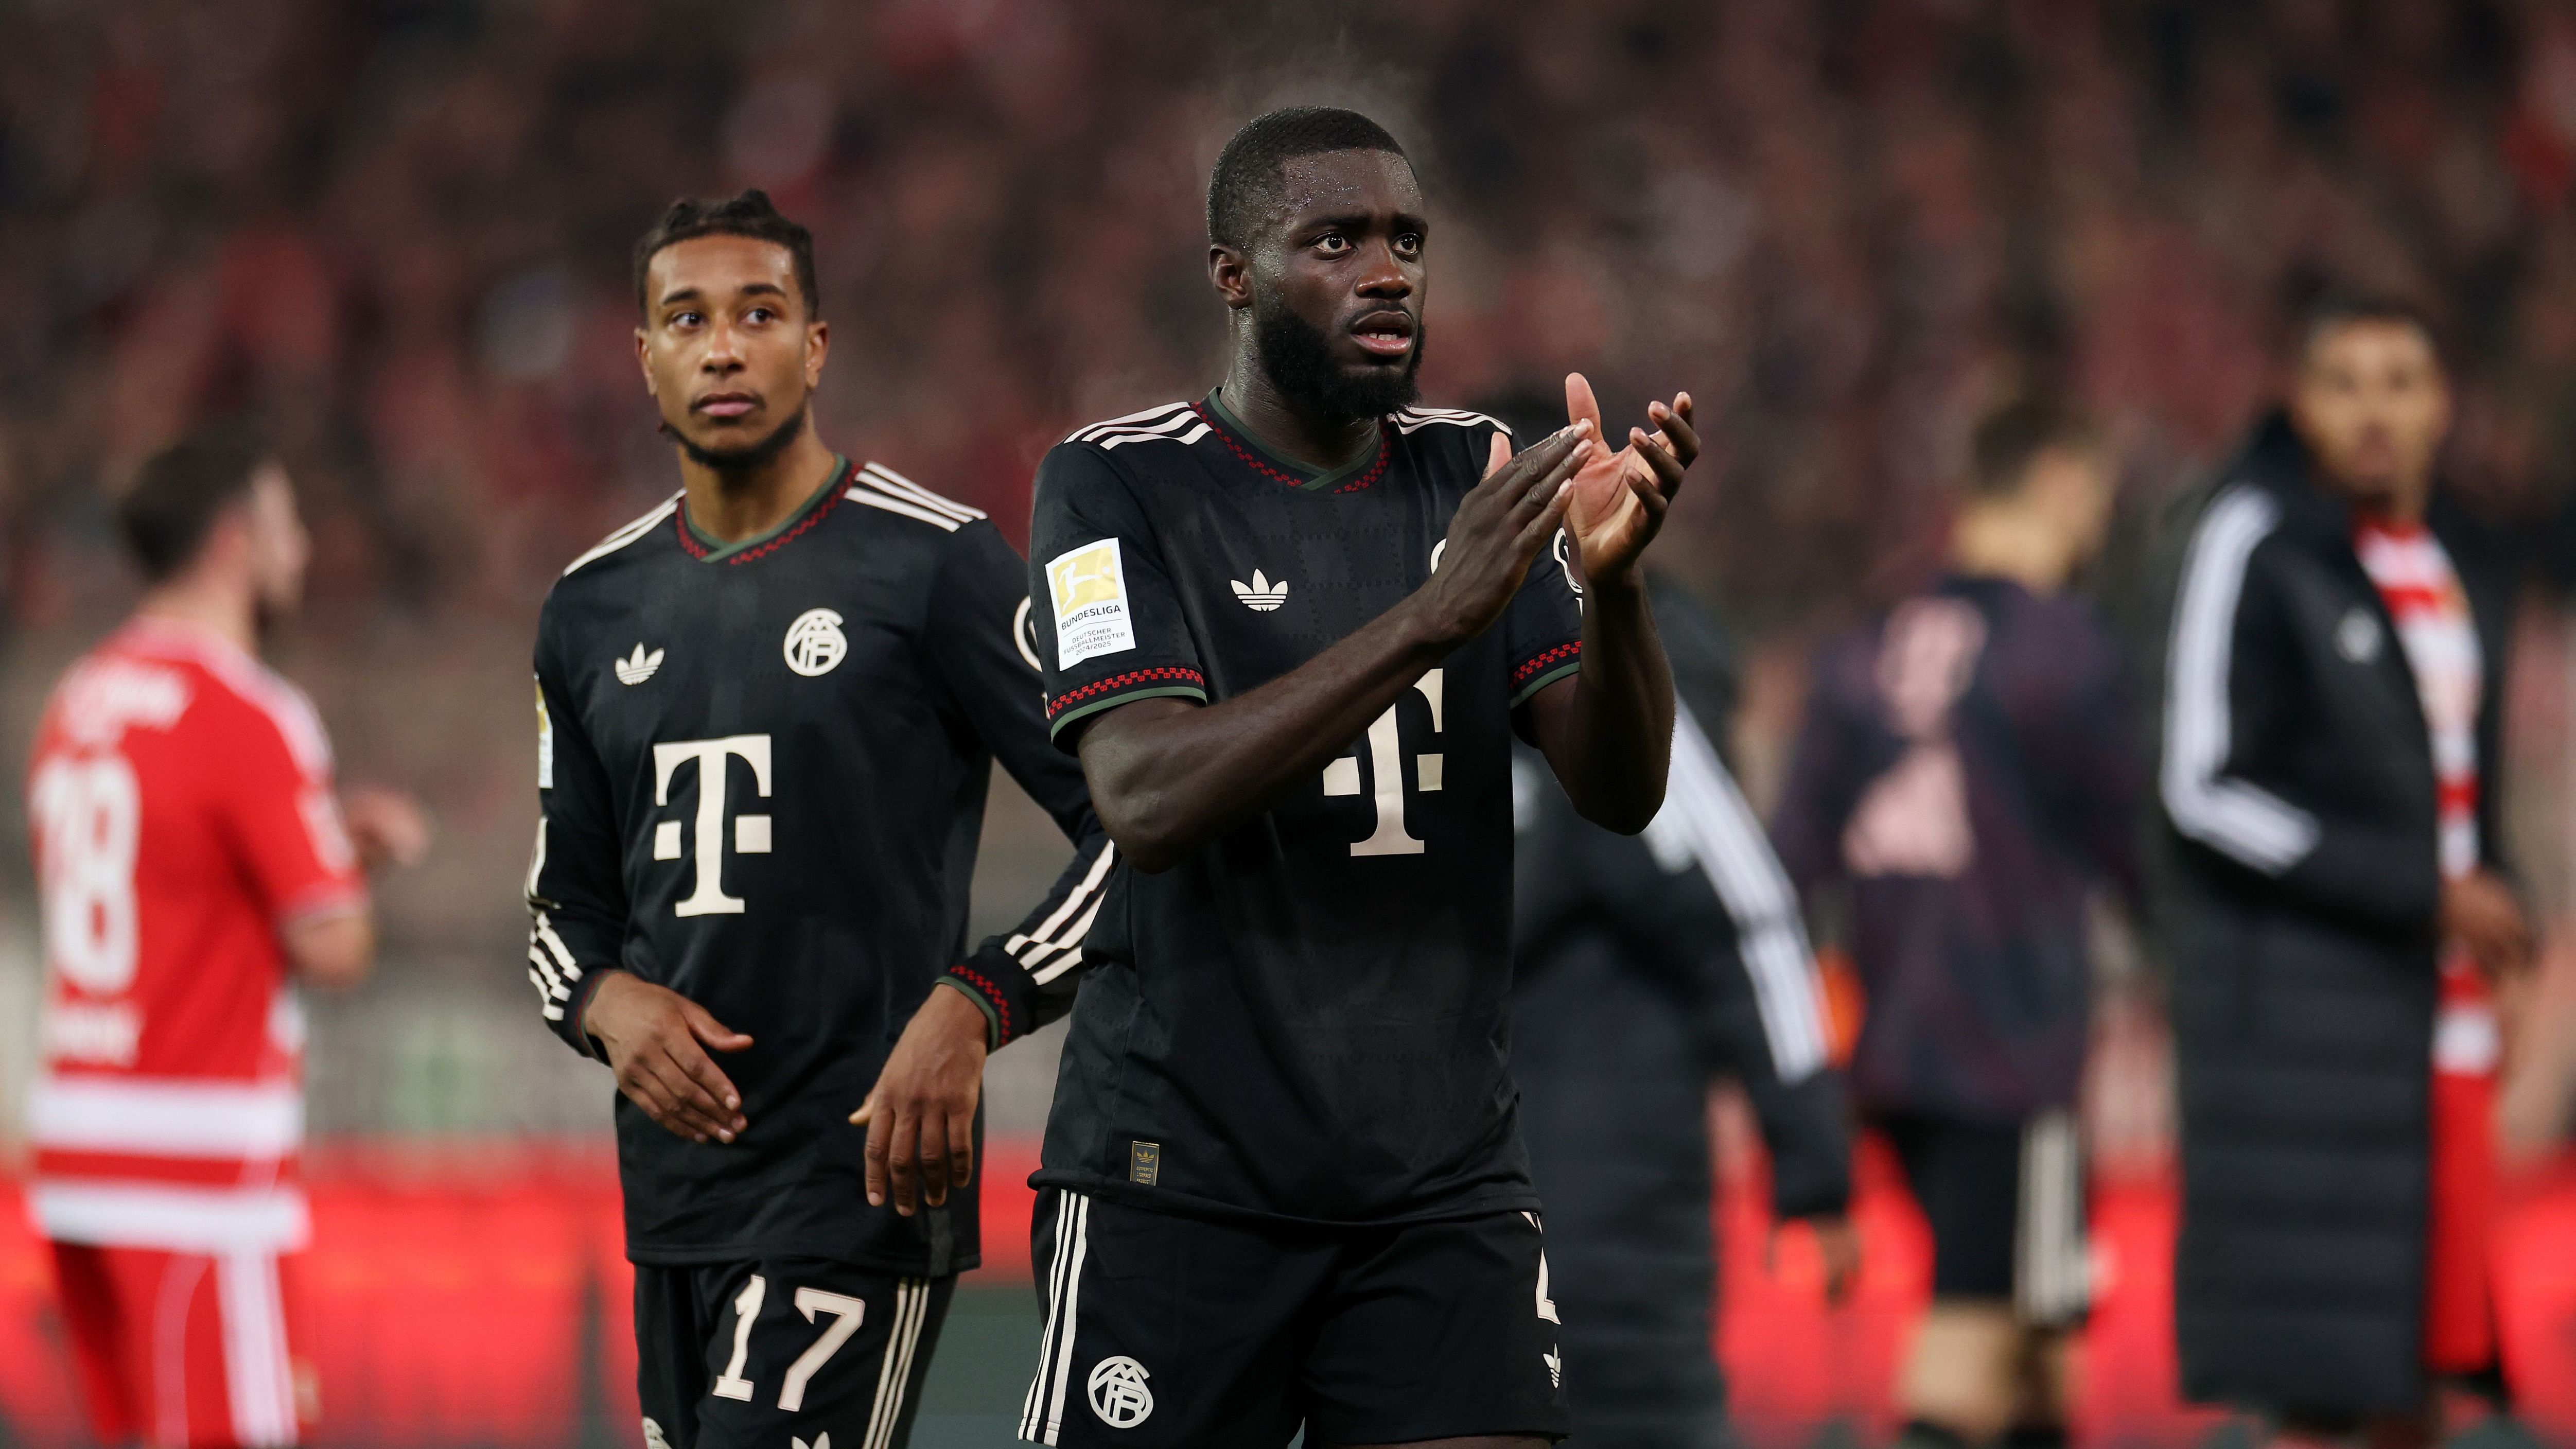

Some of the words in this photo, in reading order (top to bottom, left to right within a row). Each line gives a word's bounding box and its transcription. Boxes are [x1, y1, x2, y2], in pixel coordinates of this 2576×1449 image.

[1061, 605, 1121, 631] BUNDESLIGA
[1064, 632, 1126, 655] FUSSBALLMEISTER
[1072, 627, 1112, 643] DEUTSCHER
[1076, 641, 1111, 656] 2024/2025
[653, 734, 772, 918] T
[713, 1275, 865, 1412] 17
